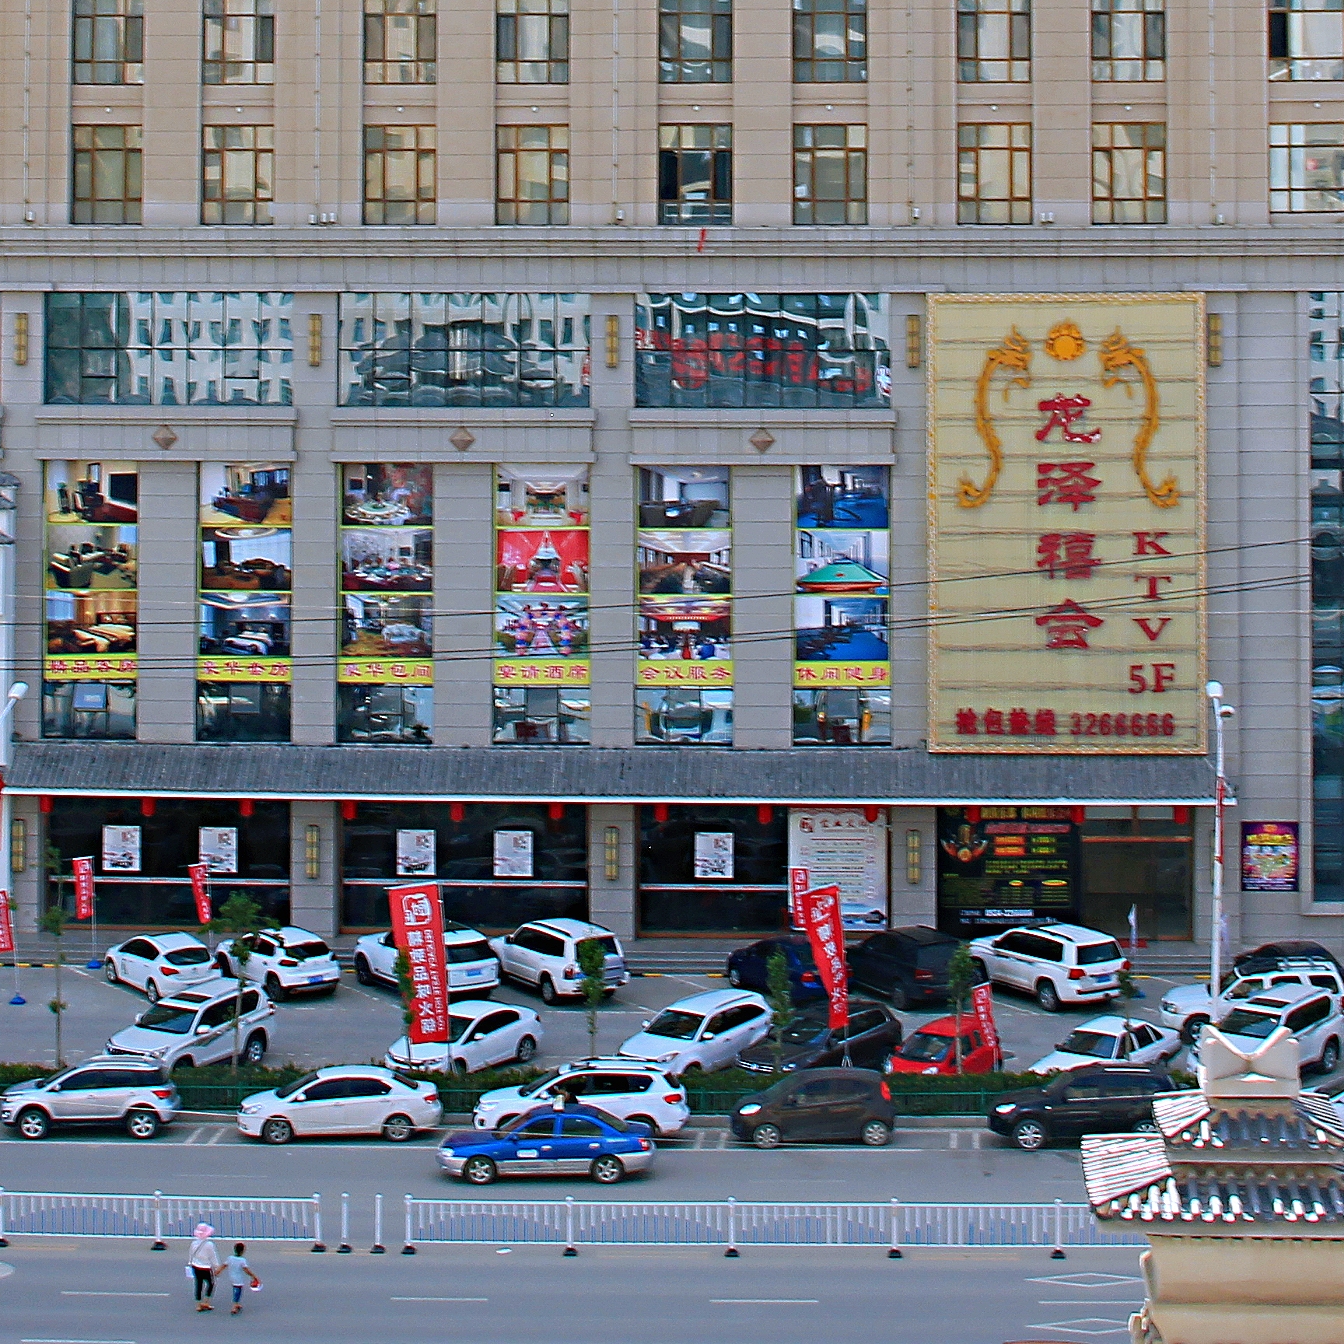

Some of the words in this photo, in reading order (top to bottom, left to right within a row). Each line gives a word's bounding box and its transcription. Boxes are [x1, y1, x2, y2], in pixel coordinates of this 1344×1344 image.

[1132, 531, 1172, 642] KTV
[640, 666, 731, 680] 会议服务
[795, 667, 889, 681] 休闲健身
[1127, 663, 1176, 693] 5F
[1069, 711, 1175, 736] 3266666
